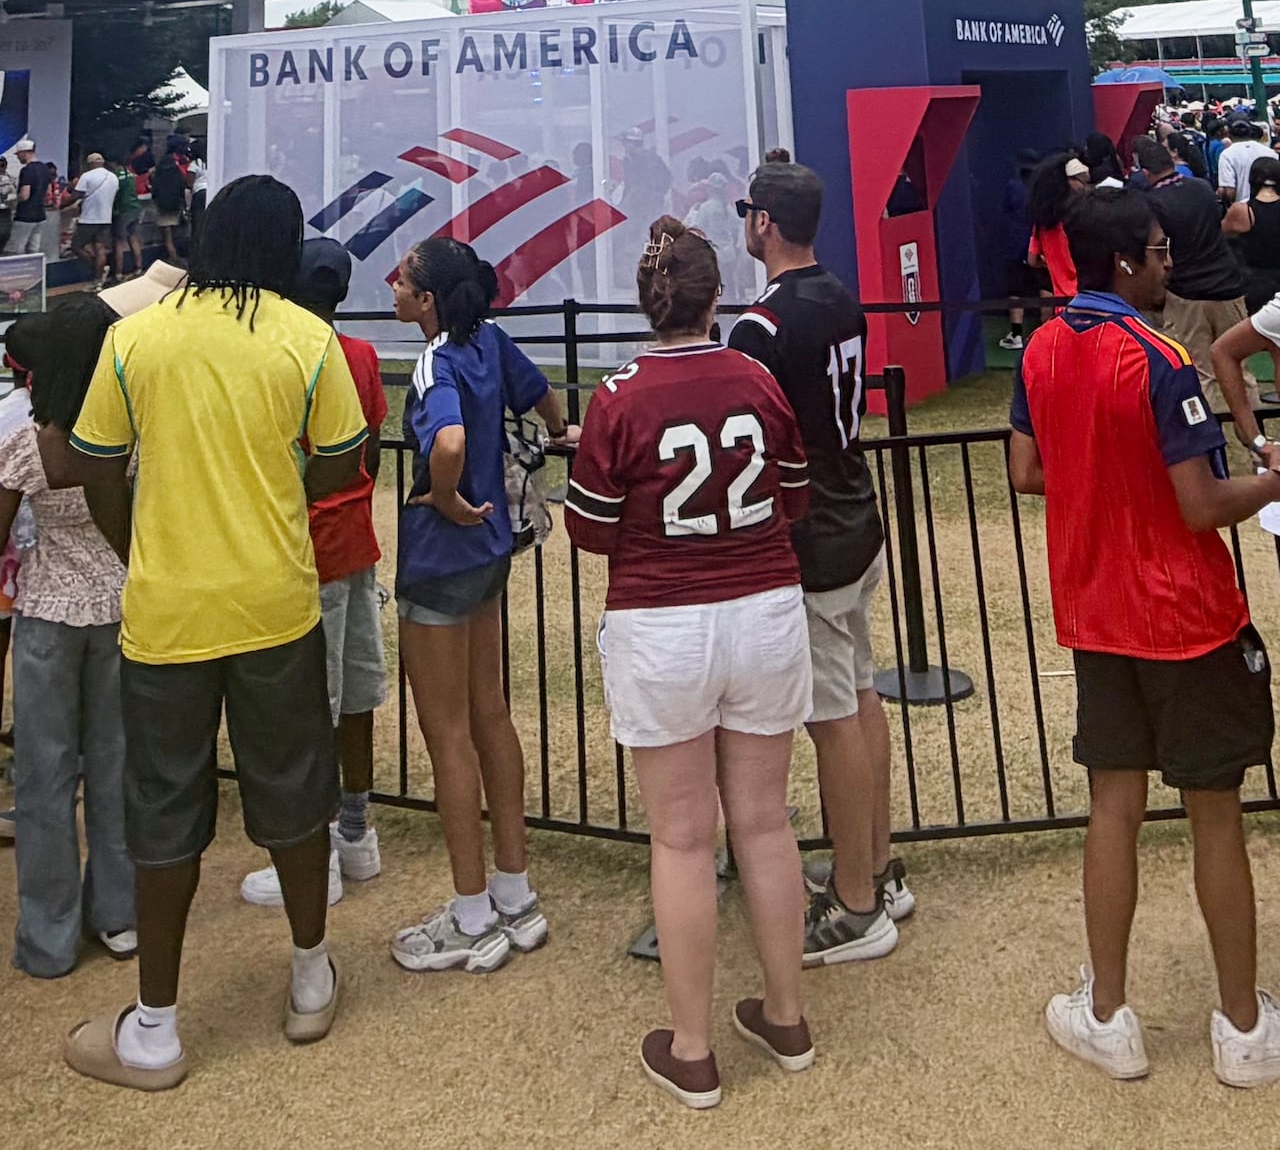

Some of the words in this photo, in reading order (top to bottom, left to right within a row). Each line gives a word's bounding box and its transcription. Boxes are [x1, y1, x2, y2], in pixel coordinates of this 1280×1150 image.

[249, 43, 368, 88] BANK
[384, 37, 441, 79] OF
[455, 18, 699, 75] AMERICA
[955, 18, 988, 42] BANK
[989, 21, 1003, 43] OF
[1004, 22, 1048, 45] AMERICA
[826, 335, 863, 450] 17
[657, 413, 775, 537] 22
